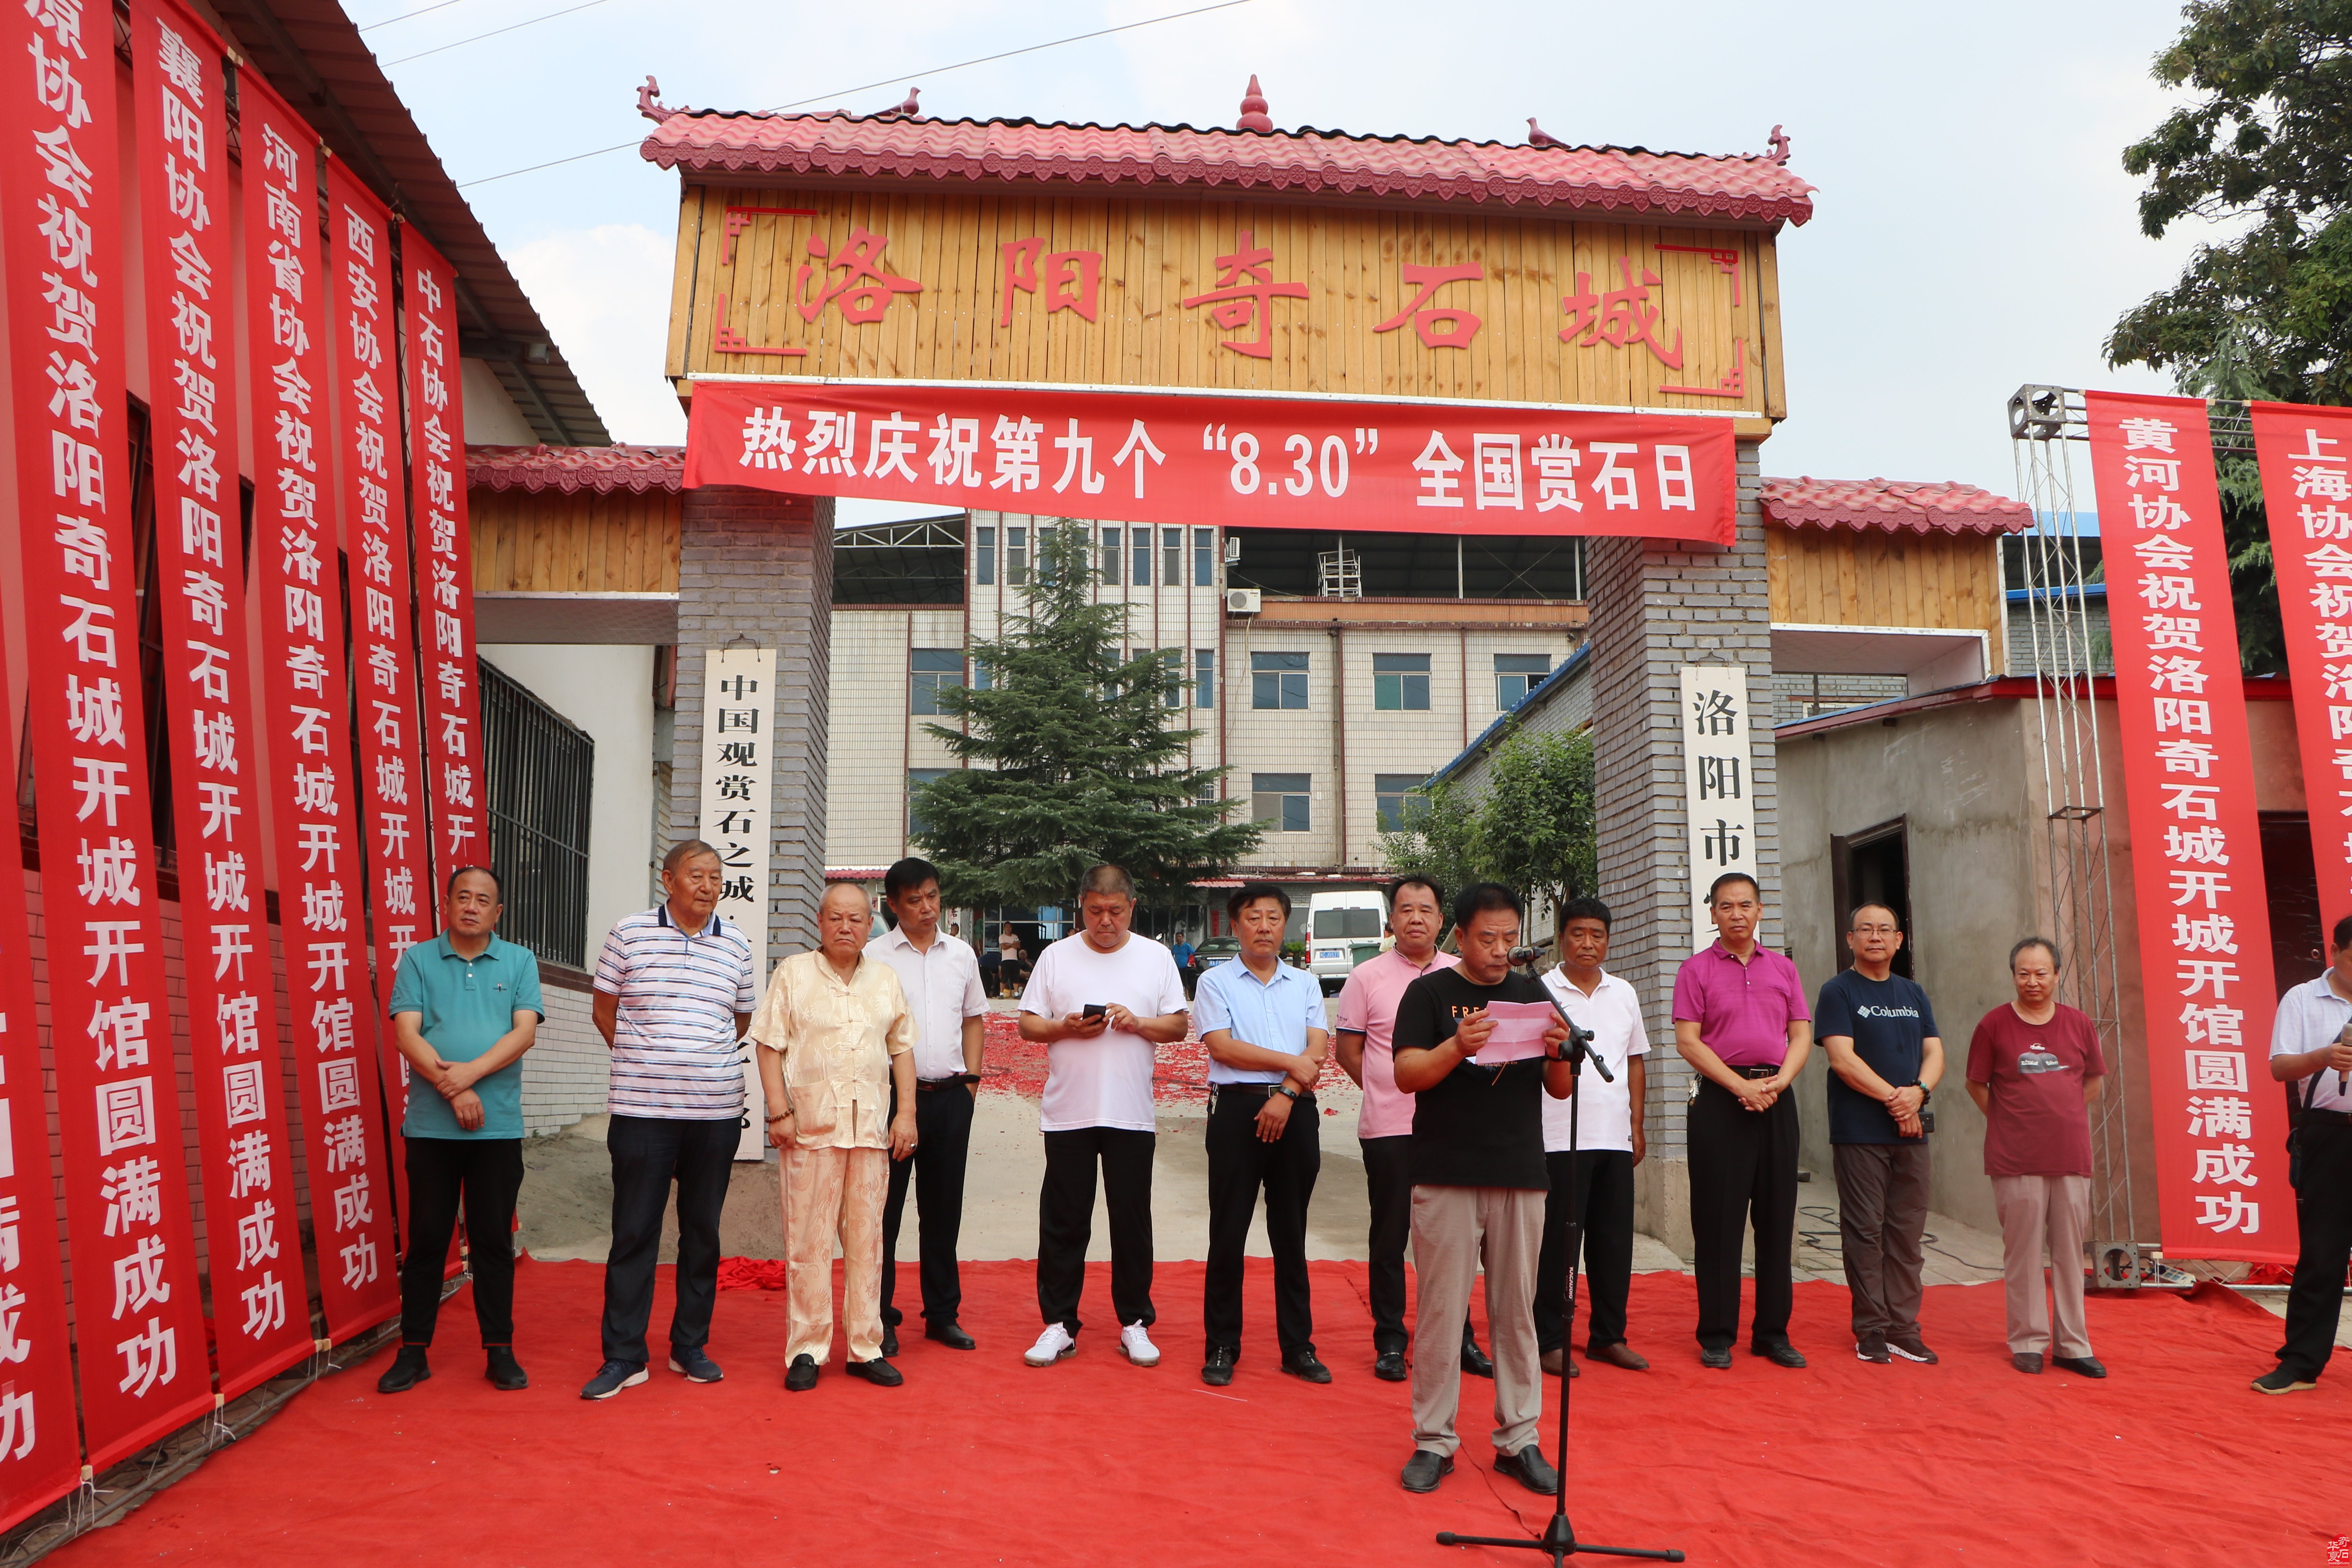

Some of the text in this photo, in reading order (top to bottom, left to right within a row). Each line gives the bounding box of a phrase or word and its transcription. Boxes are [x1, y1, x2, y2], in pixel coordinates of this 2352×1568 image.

[739, 407, 1167, 499] 热烈庆祝第九个
[1412, 430, 1695, 513] 全国赏石日
[796, 226, 1682, 370] 洛阳奇石城
[157, 17, 285, 1340] 襄阳协会祝贺洛阳奇石城开城开馆圆满成功
[262, 123, 378, 1290] 河南省协会祝贺洛阳奇石城开城开馆圆满成功
[344, 203, 417, 1116] 西安协会祝贺洛阳奇石城开城开
[417, 269, 475, 869] 中石协会祝贺洛阳奇石城开
[1693, 690, 1744, 933] 洛阳市
[2119, 417, 2259, 1234] 黄河协会祝贺洛阳奇石城开城开馆圆满成功
[2288, 429, 2352, 895] 上海协会祝贺
[1870, 1005, 1919, 1018] Columbia
